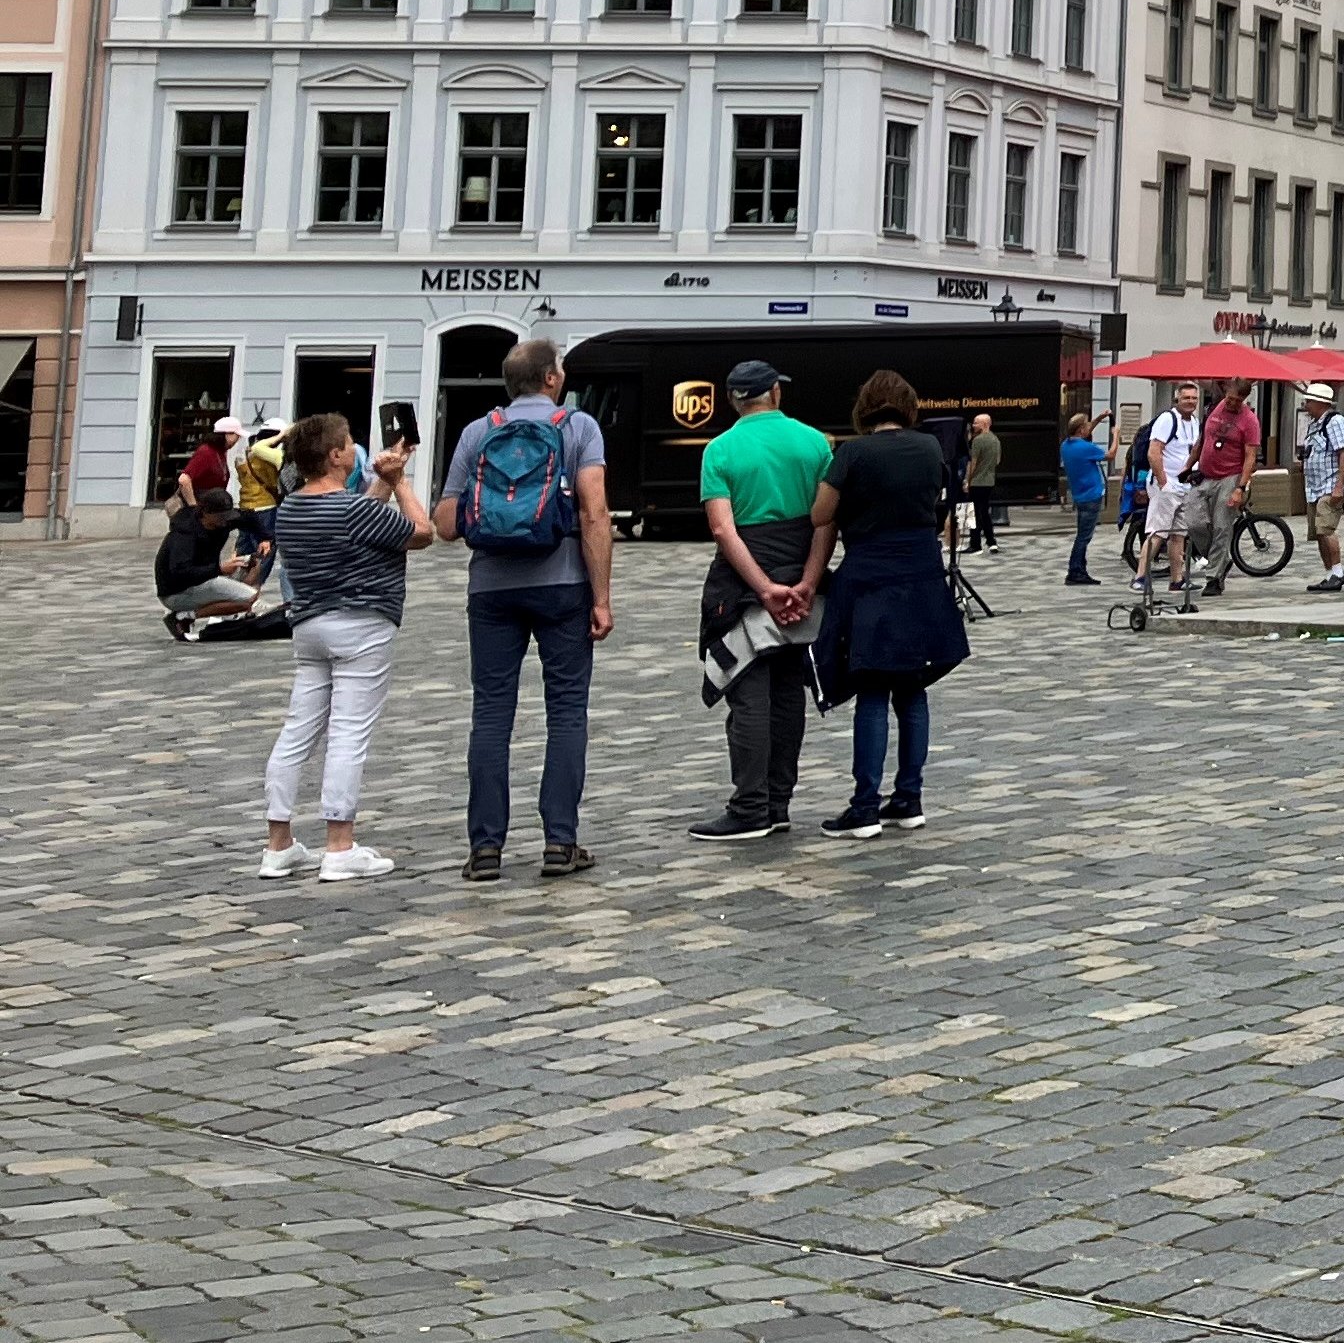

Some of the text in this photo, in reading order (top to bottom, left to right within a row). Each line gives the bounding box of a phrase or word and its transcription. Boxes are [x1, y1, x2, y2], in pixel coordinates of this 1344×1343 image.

[420, 269, 541, 291] MEISSEN
[937, 277, 988, 300] MEISSEN
[1213, 311, 1262, 335] ONTAR
[676, 395, 711, 421] ups
[962, 397, 1039, 409] Dienstleistungen
